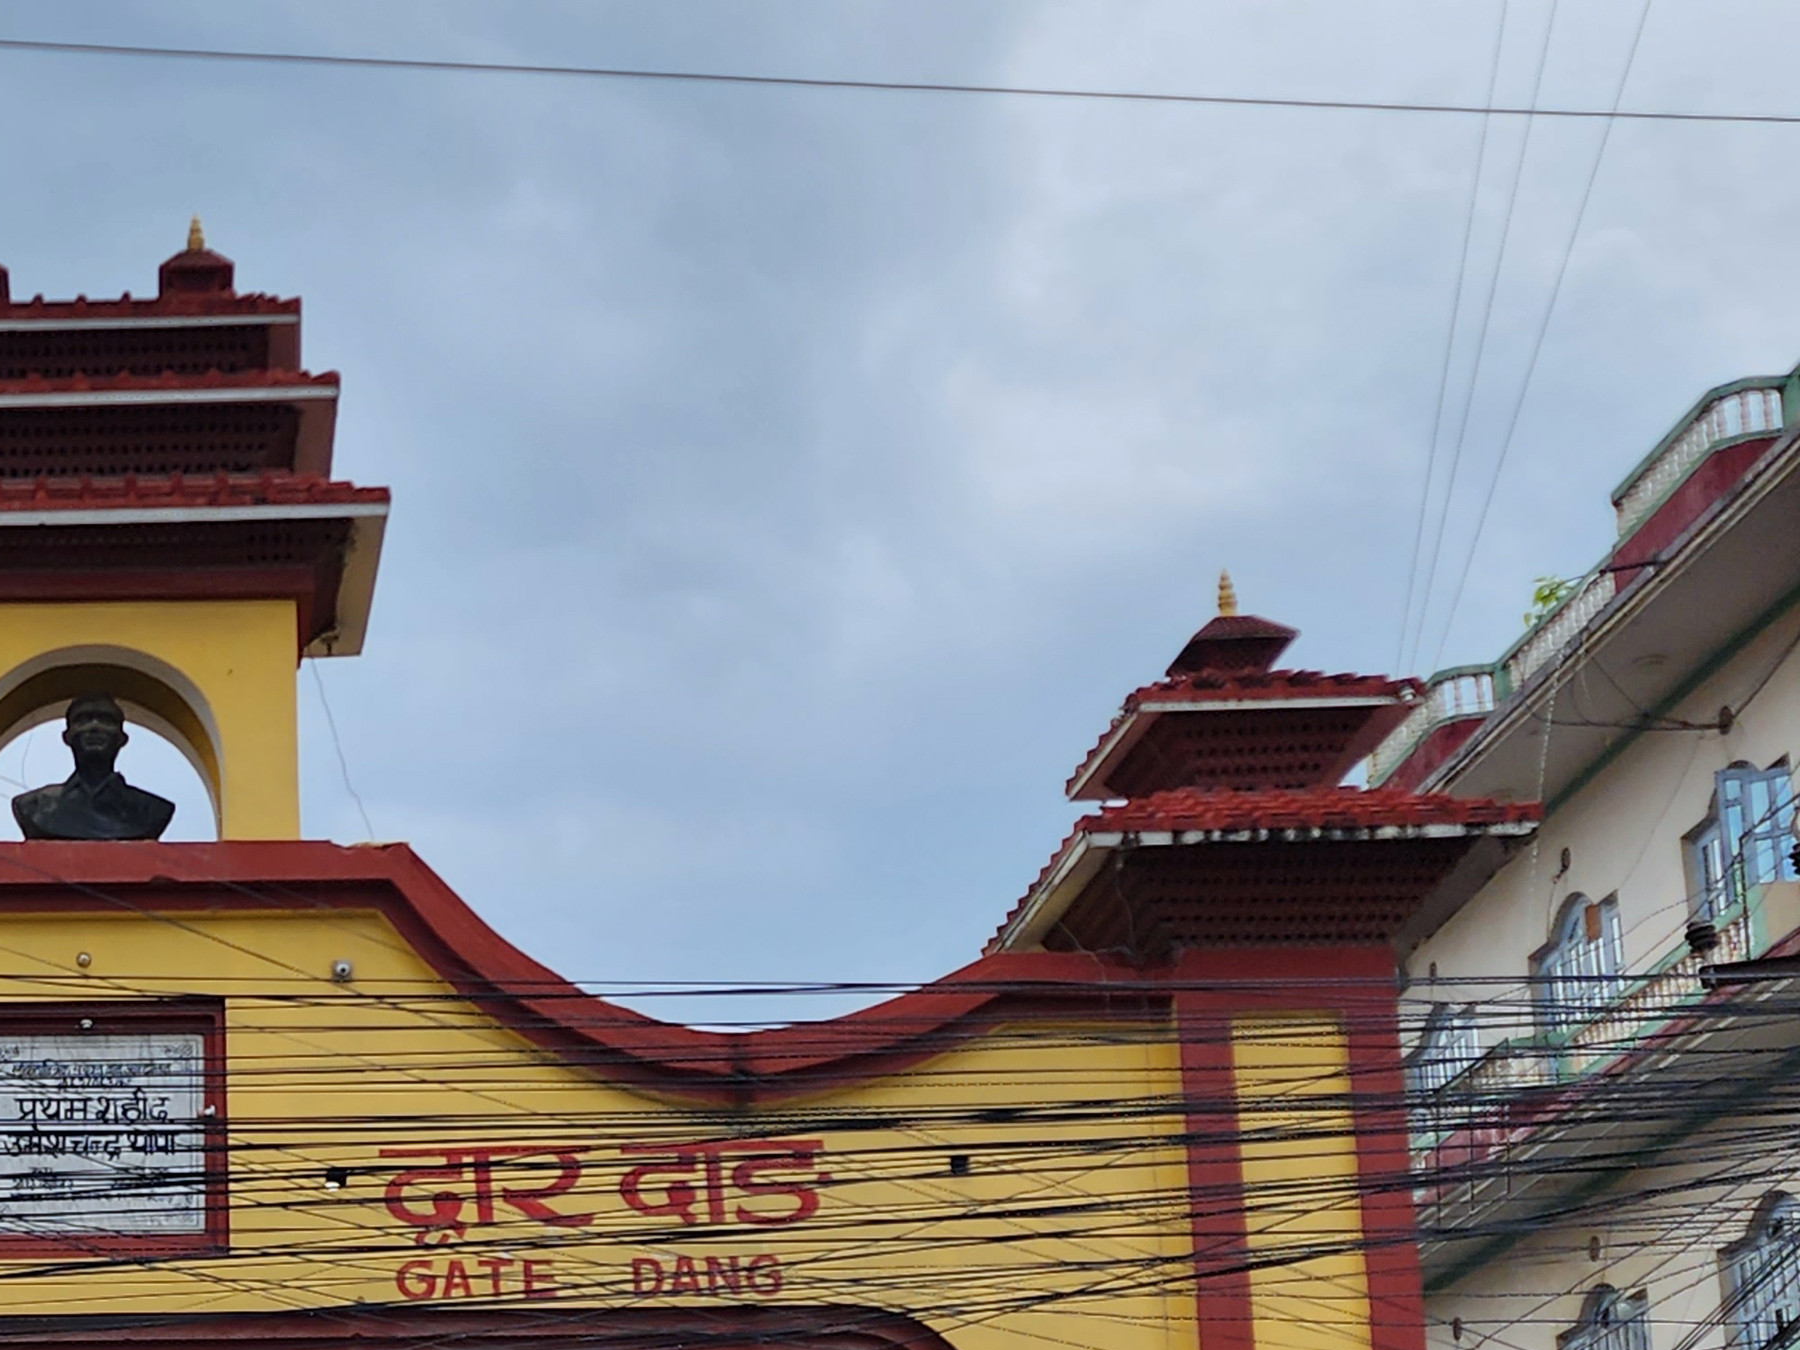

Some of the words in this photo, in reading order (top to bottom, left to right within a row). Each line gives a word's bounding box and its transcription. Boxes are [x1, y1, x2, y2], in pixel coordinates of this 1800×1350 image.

[14, 1097, 93, 1121] प्रथम
[95, 1087, 175, 1124] शहीद
[395, 1258, 559, 1301] GATE
[631, 1253, 784, 1298] DANG
